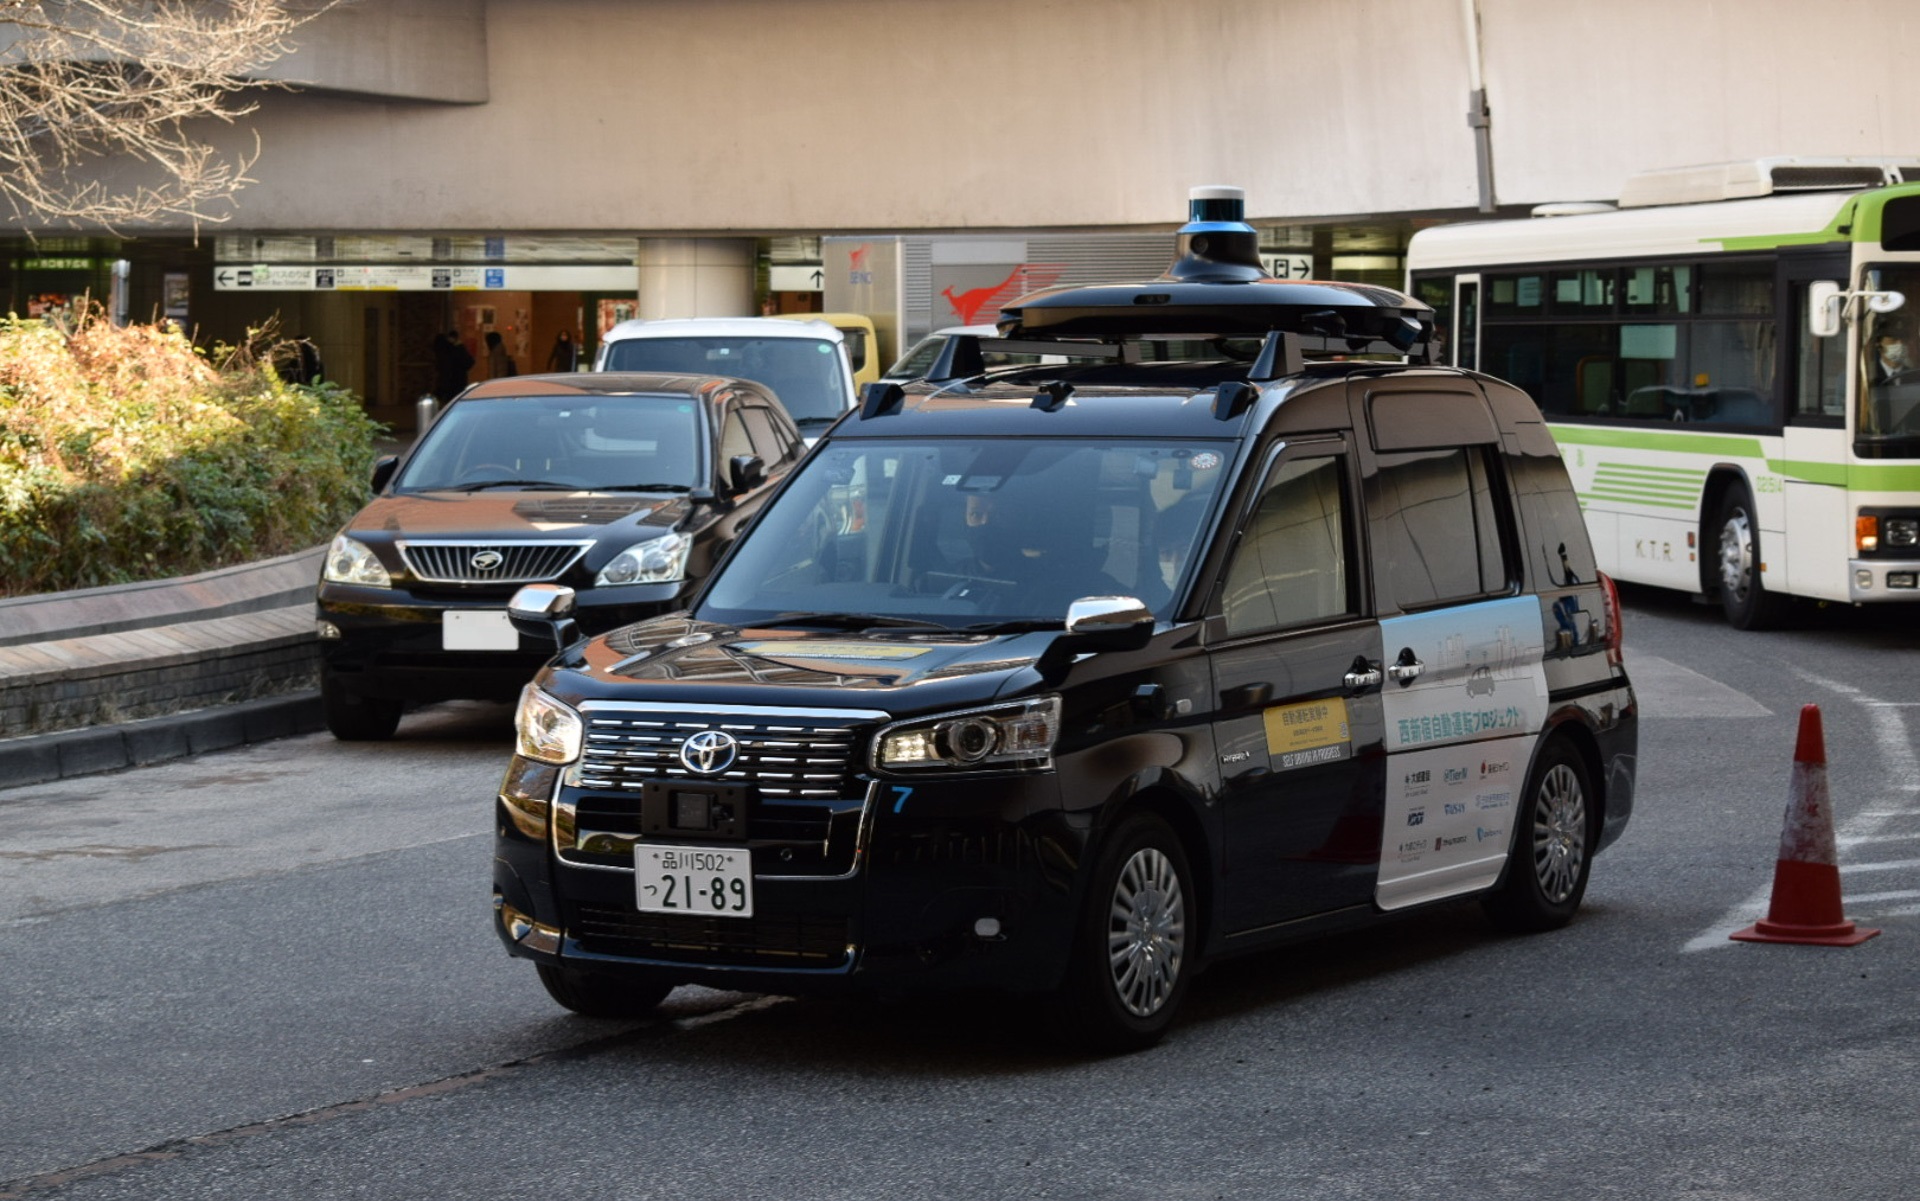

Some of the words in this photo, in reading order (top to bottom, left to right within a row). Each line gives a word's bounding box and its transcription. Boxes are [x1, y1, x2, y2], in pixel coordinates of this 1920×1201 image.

[1397, 705, 1519, 744] 西新宿自動運転プロジェクト
[891, 786, 913, 813] 7
[662, 851, 725, 872] 品川502
[643, 884, 658, 897] つ
[661, 874, 747, 912] 21-89
